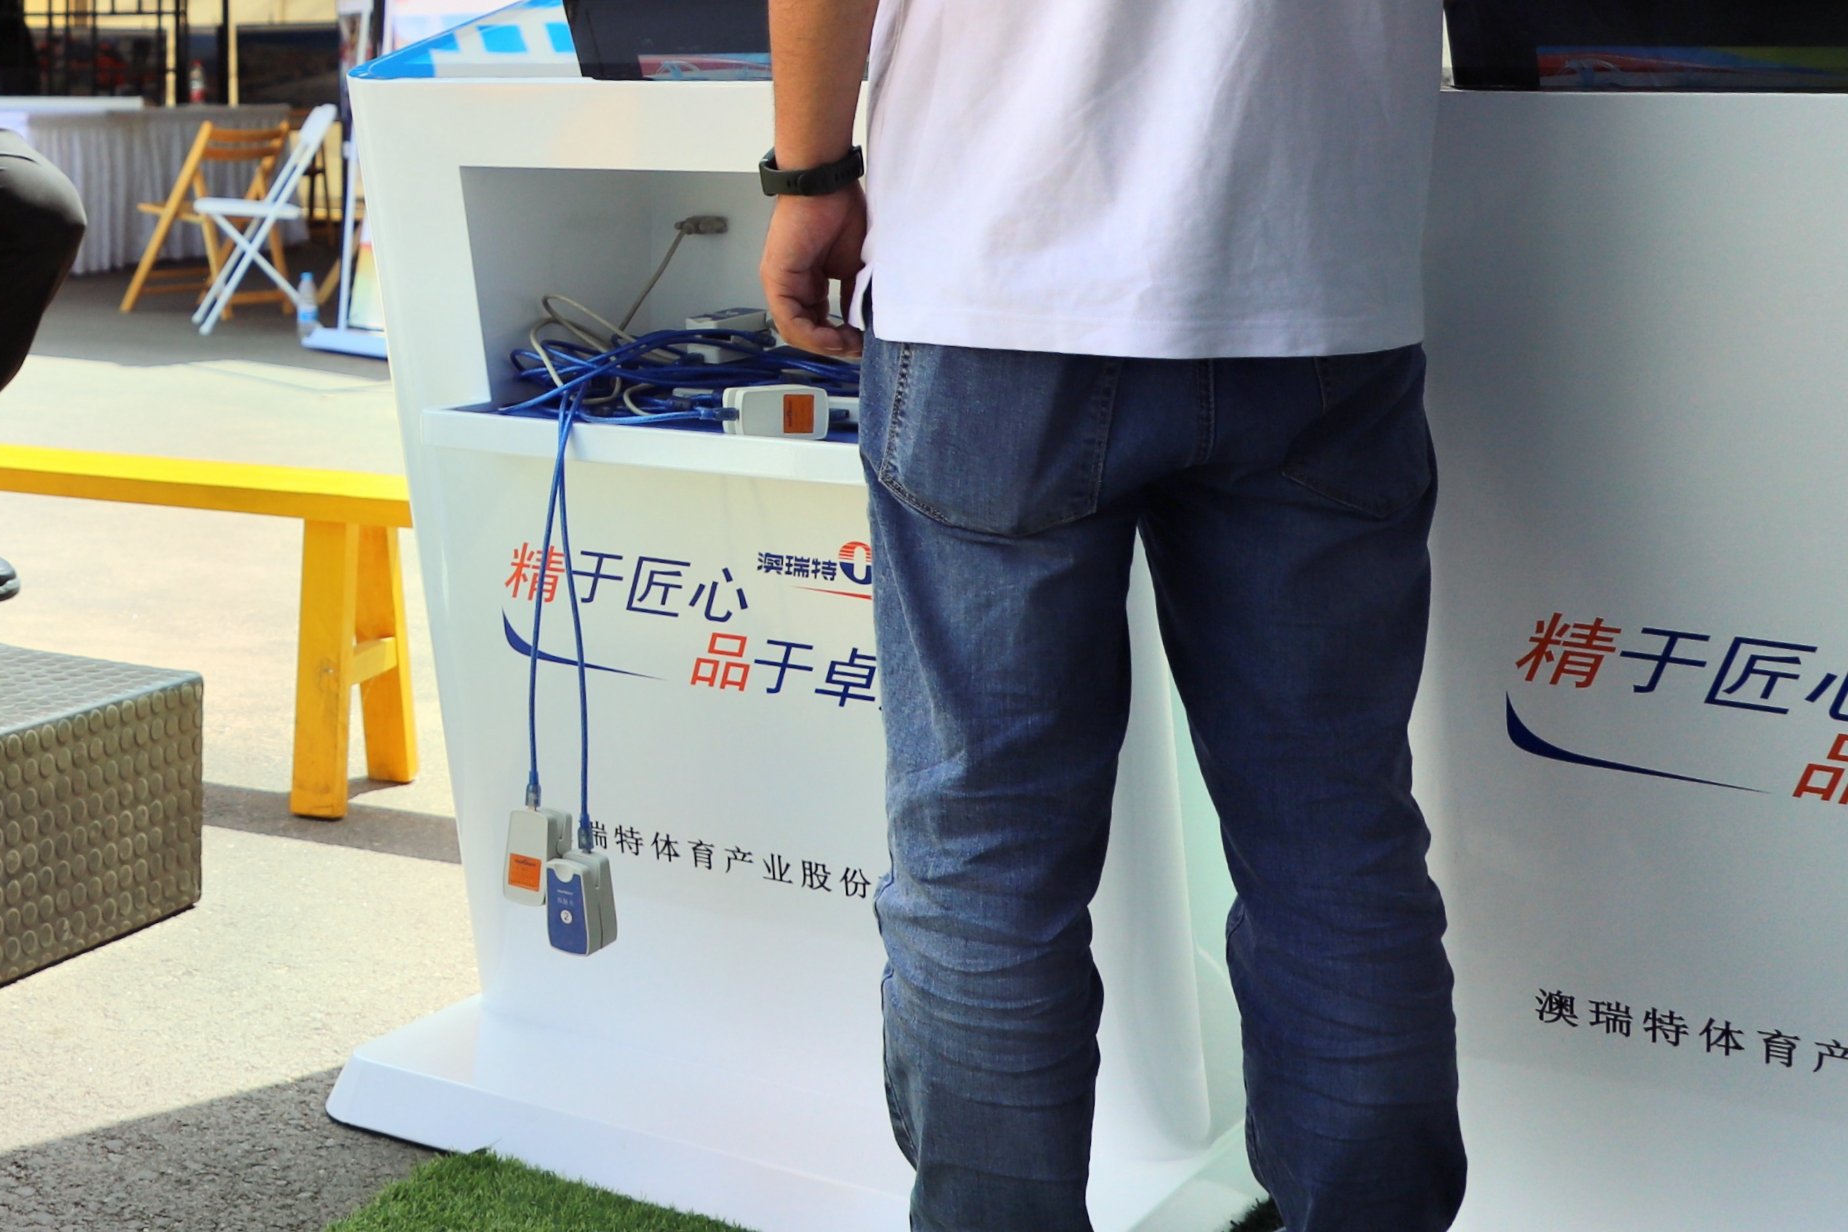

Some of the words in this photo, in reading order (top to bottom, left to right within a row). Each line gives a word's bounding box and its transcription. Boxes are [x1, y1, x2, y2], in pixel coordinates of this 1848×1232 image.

[504, 541, 750, 624] 精于匠心
[1534, 988, 1848, 1073] 澳瑞特体育产
